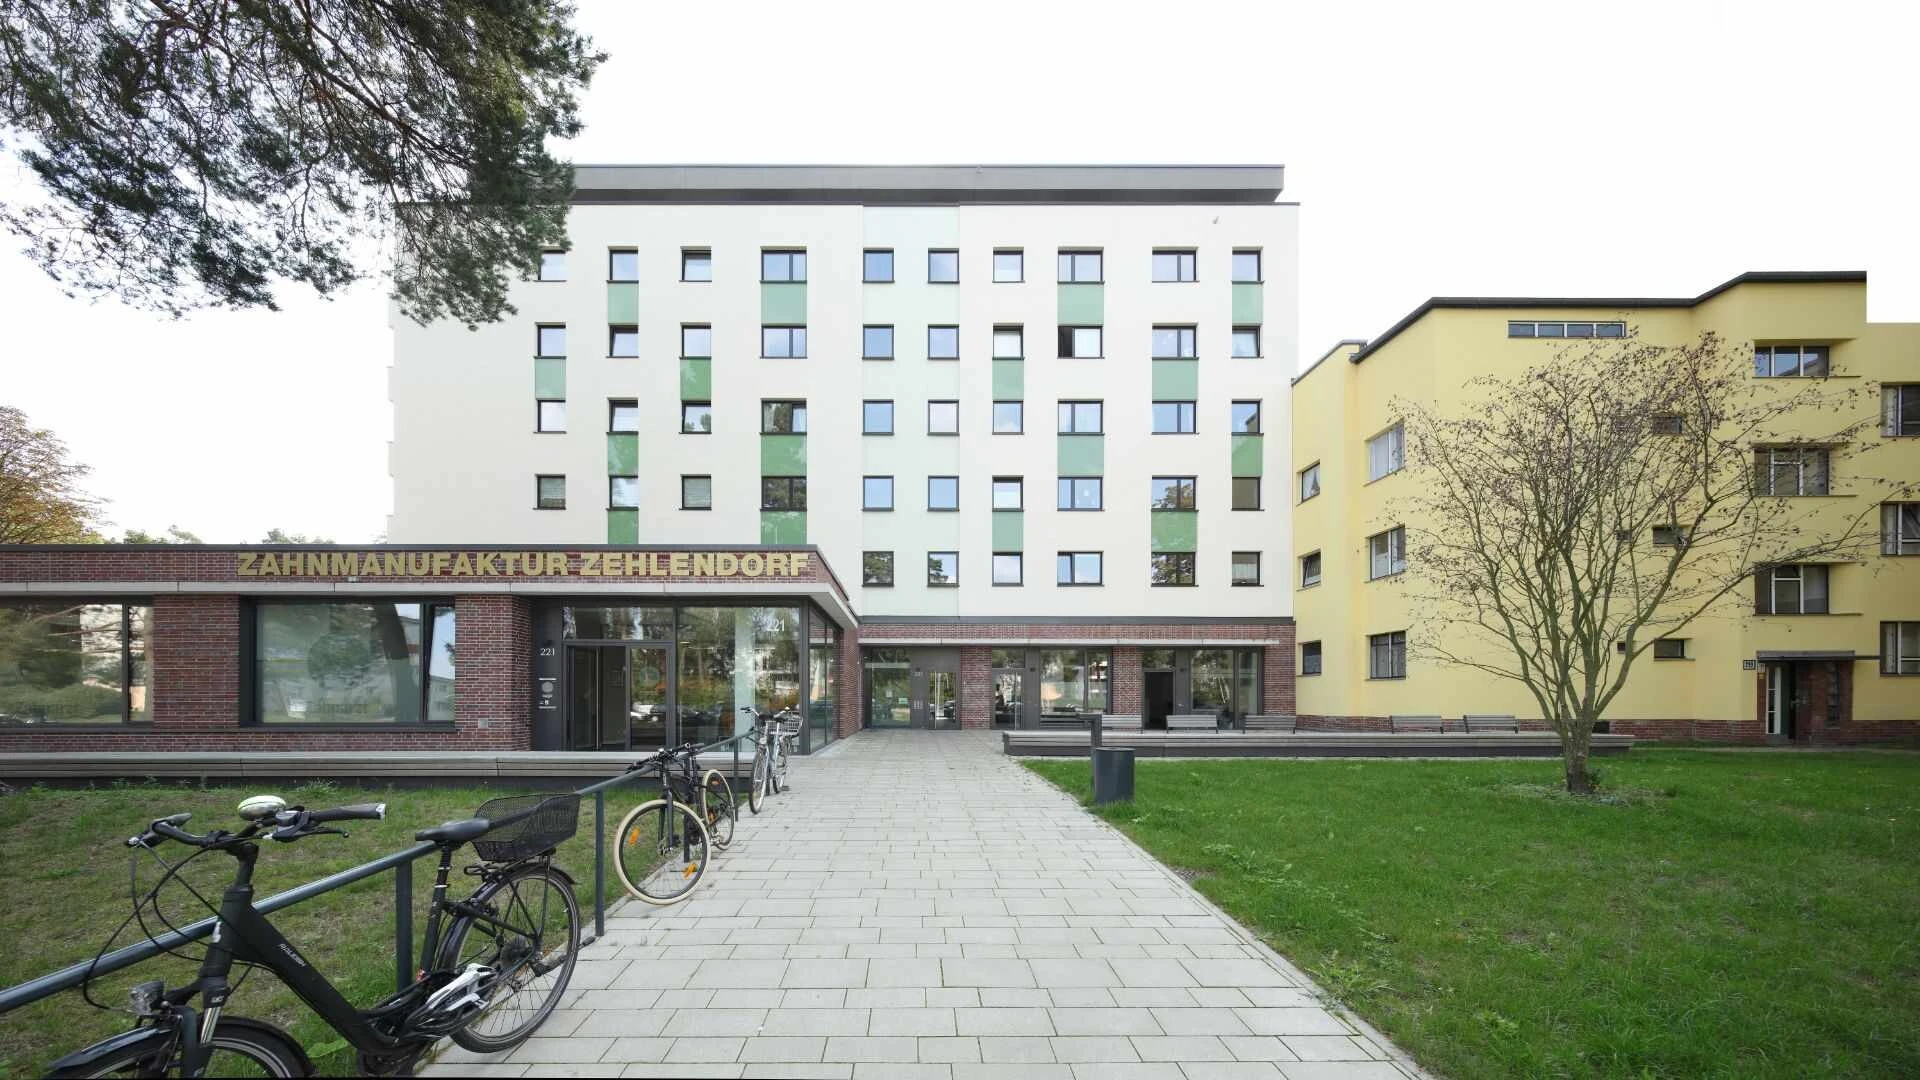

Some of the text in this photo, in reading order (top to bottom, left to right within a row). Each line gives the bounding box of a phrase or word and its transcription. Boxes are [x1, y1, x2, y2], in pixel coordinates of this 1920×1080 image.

[237, 552, 809, 577] ZAHNMANUFAKTUR ZEHLENDORF
[540, 647, 555, 656] 221
